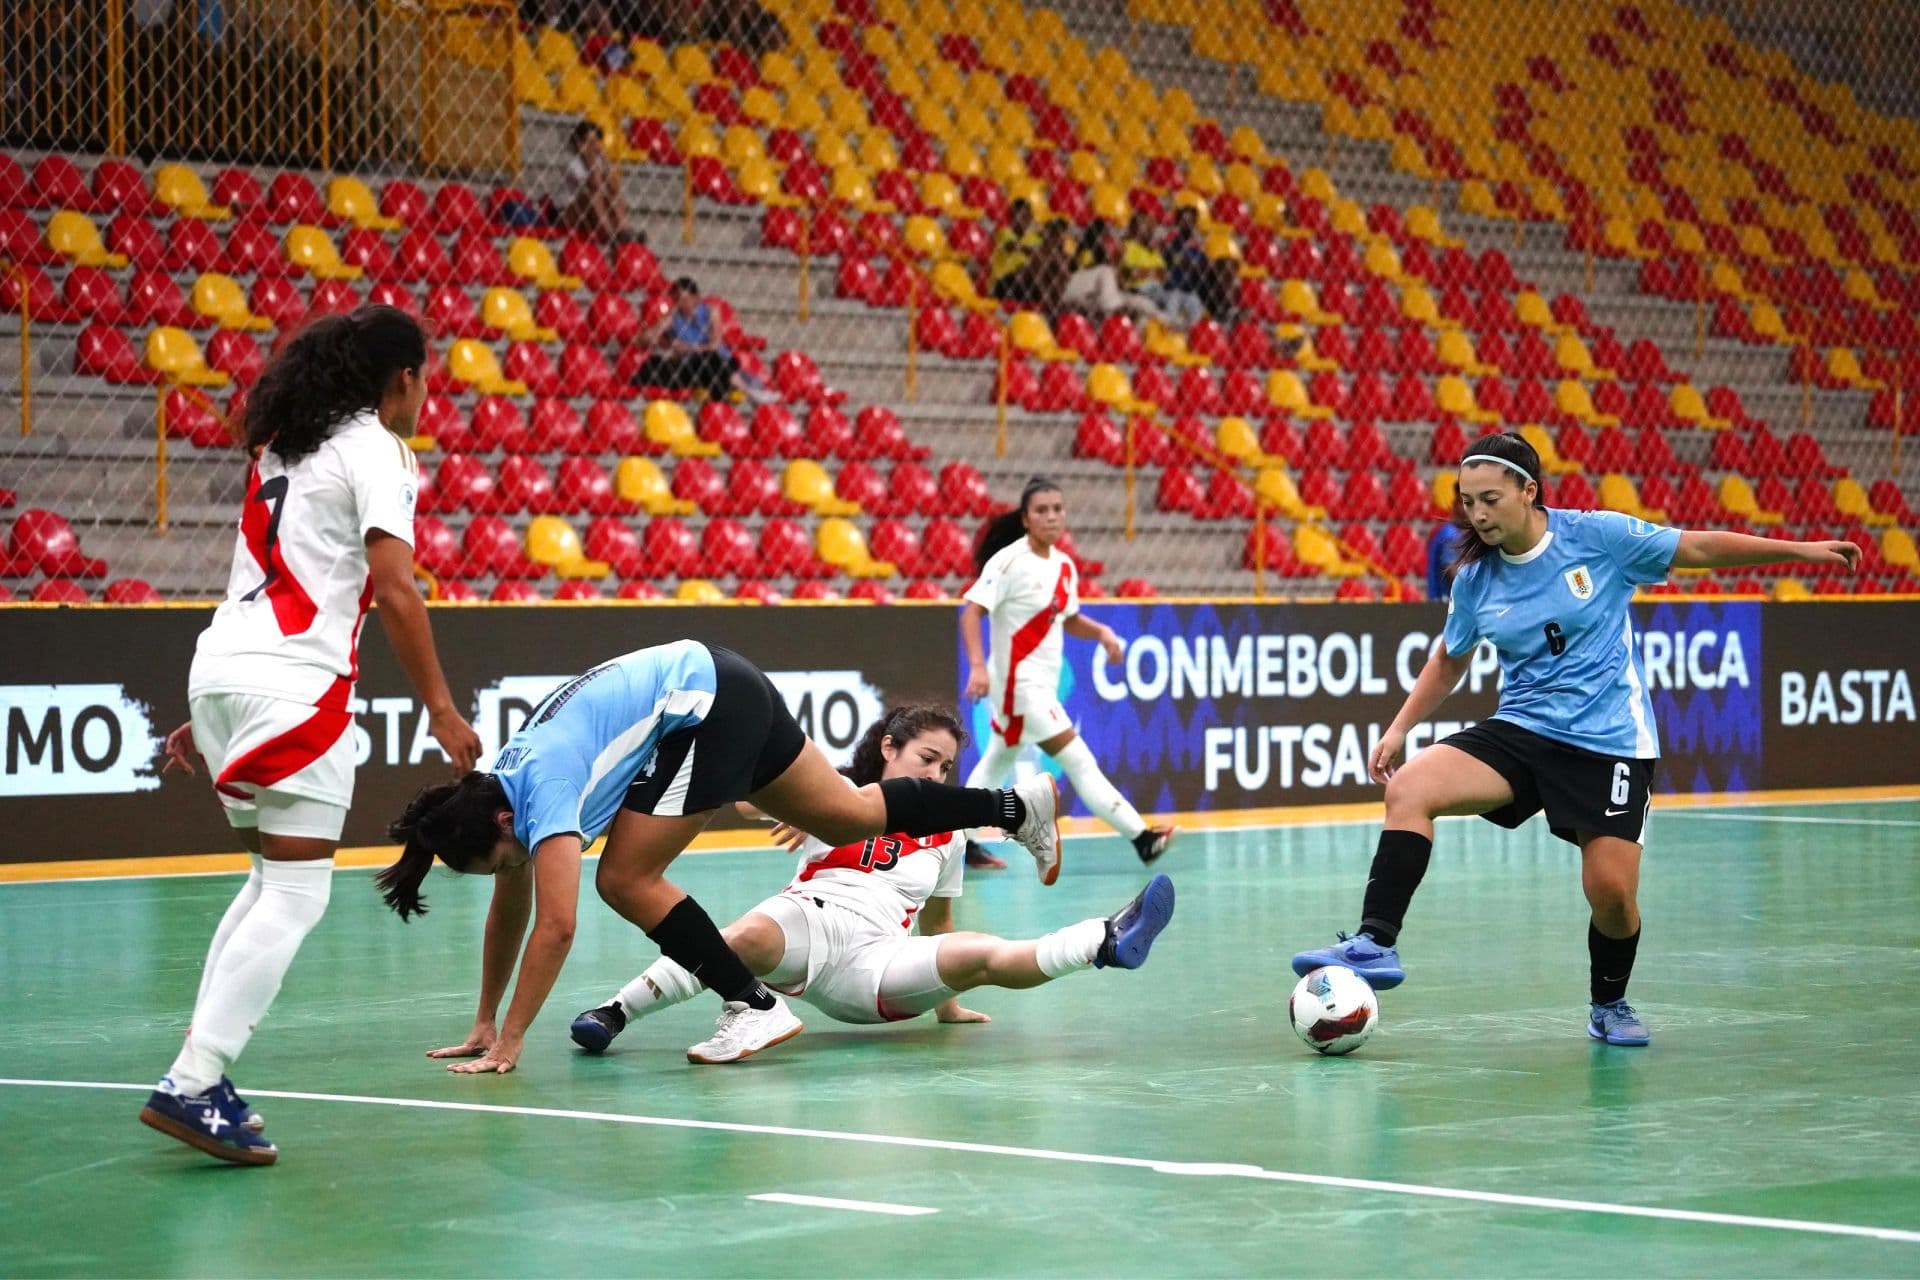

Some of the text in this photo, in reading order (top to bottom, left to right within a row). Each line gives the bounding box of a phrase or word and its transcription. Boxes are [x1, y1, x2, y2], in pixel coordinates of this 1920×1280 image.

[240, 475, 289, 602] 7
[1091, 631, 1387, 702] CONMEBOL
[1634, 630, 1750, 690] RICA
[1543, 622, 1567, 656] 6
[1780, 669, 1917, 727] BASTA
[5, 704, 123, 774] MO
[1611, 761, 1631, 805] 6
[859, 836, 903, 872] 13
